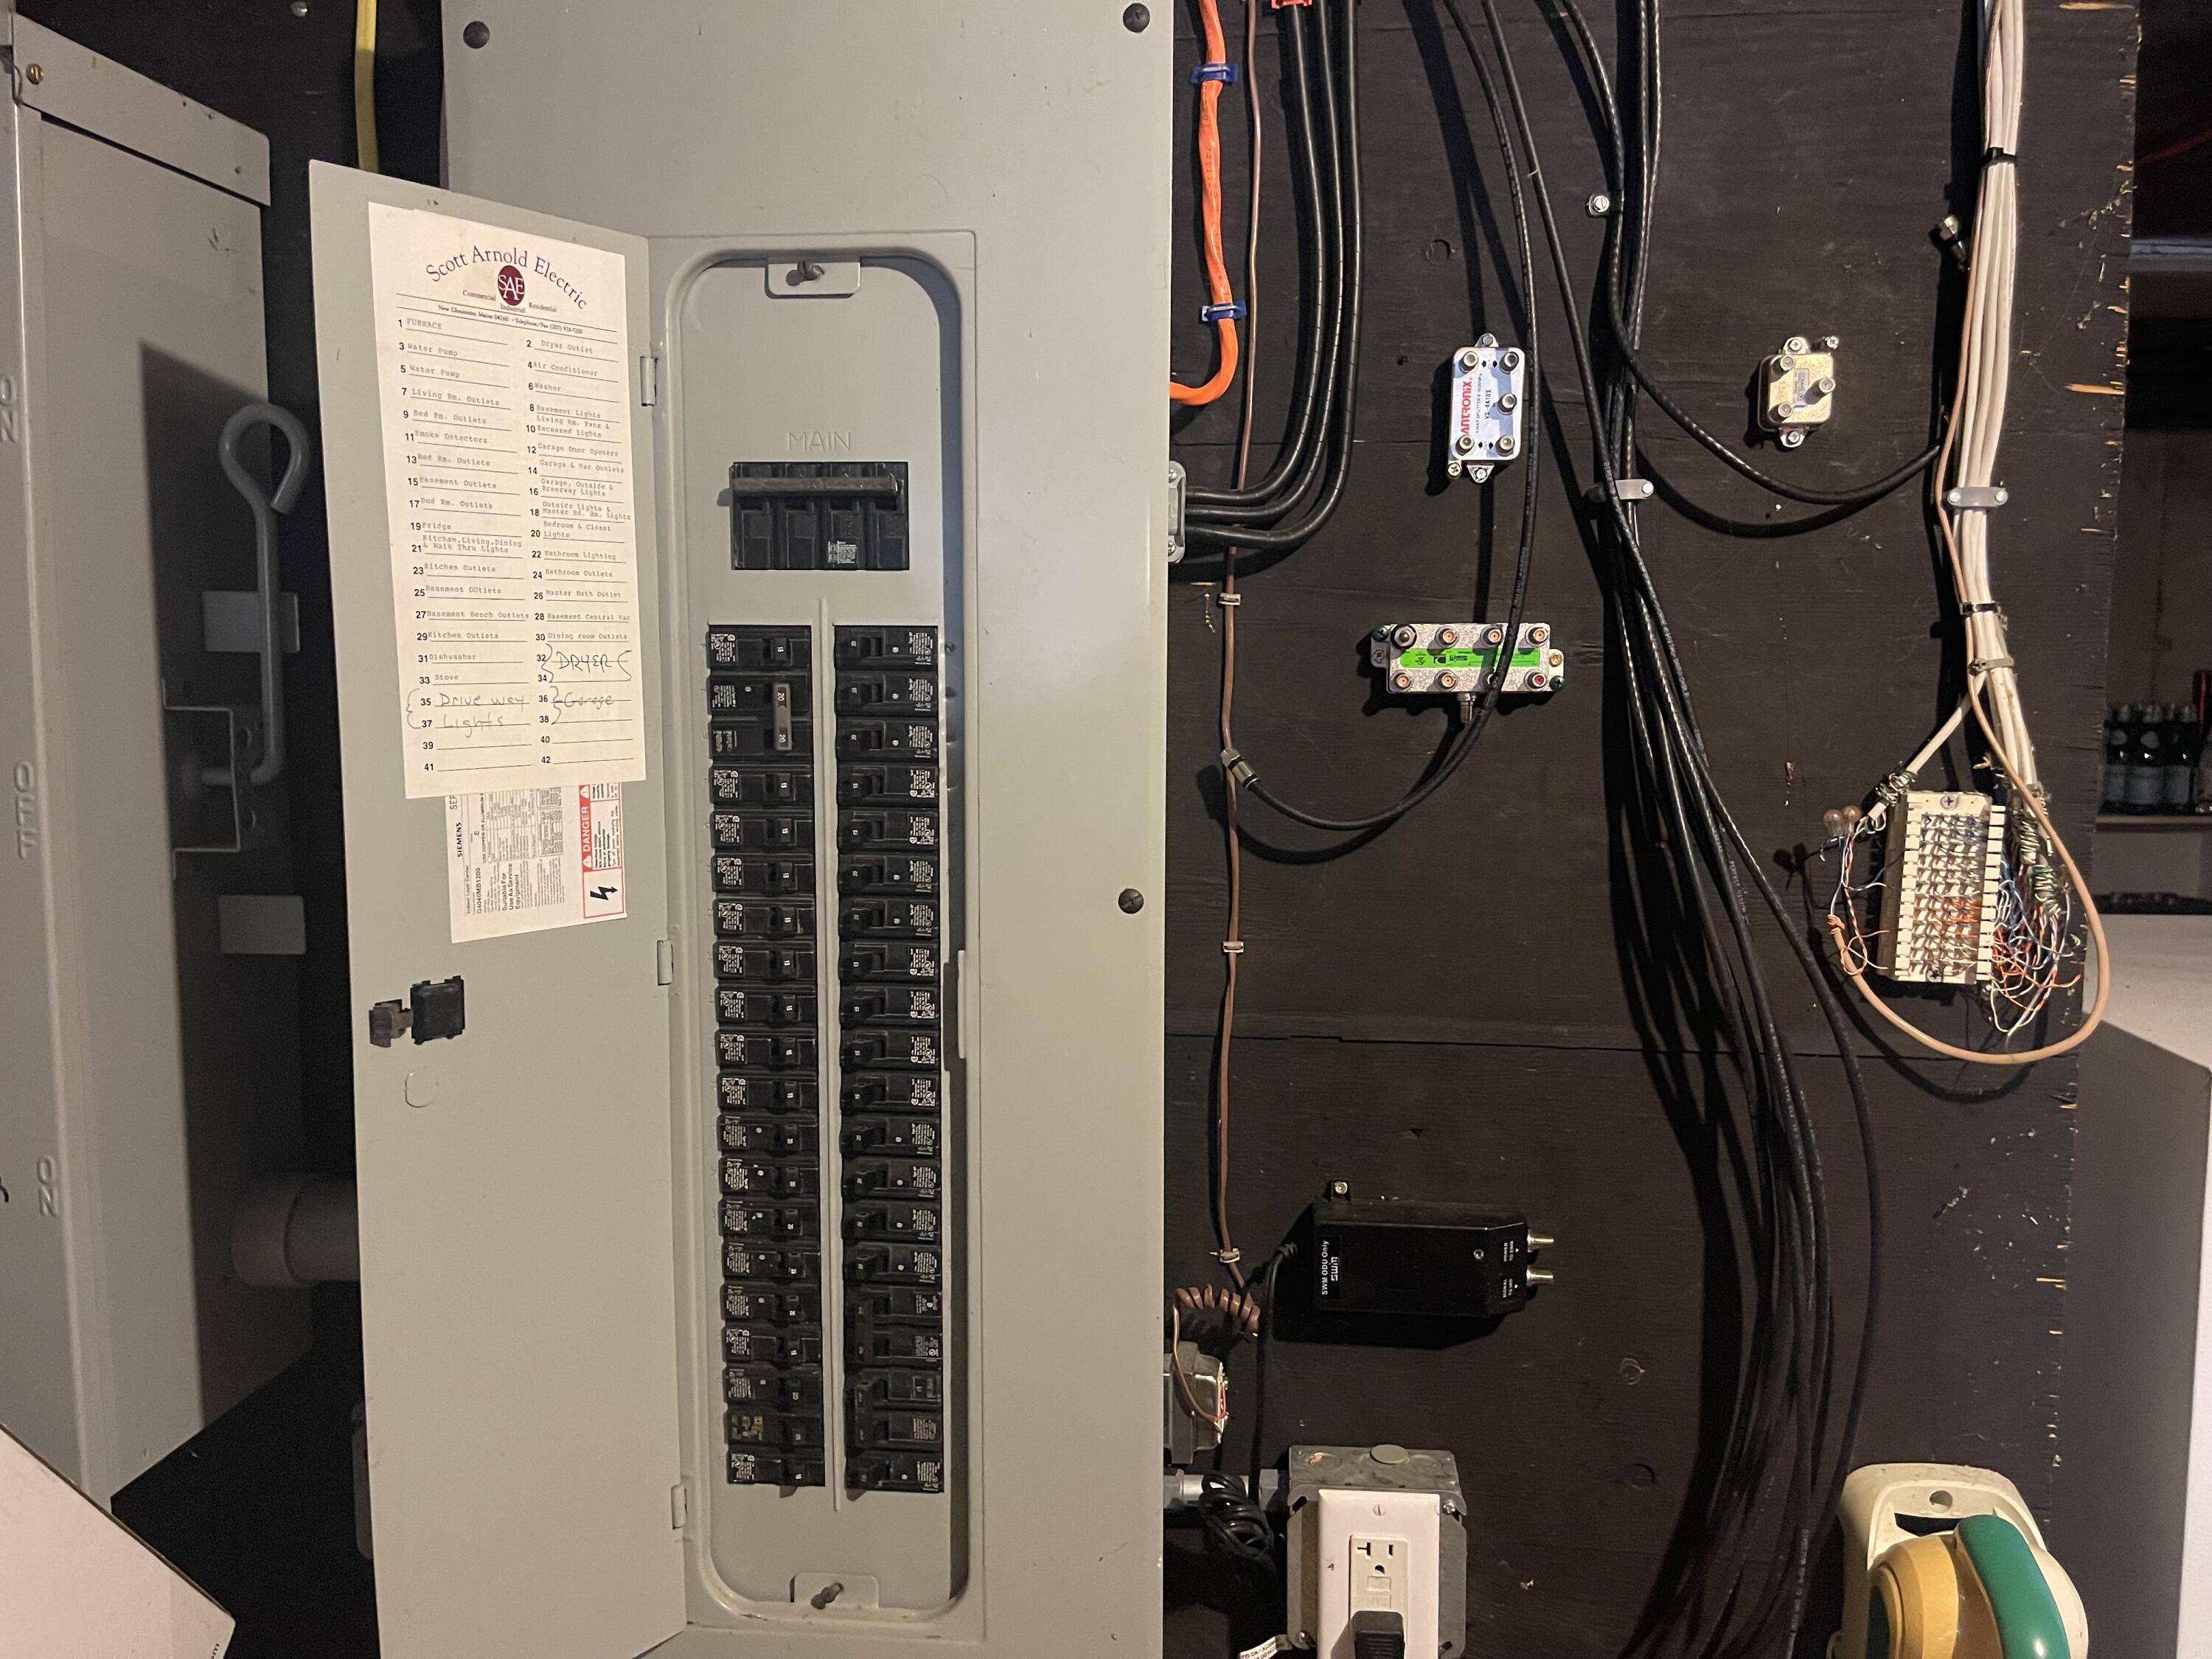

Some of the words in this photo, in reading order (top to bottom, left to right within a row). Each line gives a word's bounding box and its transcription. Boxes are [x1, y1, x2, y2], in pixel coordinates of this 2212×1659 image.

[426, 253, 468, 282] Scott
[473, 245, 527, 268] Arnold
[535, 256, 587, 310] Electric
[498, 275, 525, 301] SAE
[462, 290, 496, 301] Commercial
[529, 302, 557, 313] Residential
[398, 319, 402, 327] 1
[406, 318, 442, 330] FURNACE
[399, 342, 404, 350] 3
[408, 343, 433, 352] Water
[438, 347, 458, 357] Pump
[541, 340, 563, 349] Dryer
[567, 344, 593, 354] Outlet
[400, 365, 406, 373] 5
[409, 365, 435, 375] Water
[440, 369, 460, 378] Pump
[533, 361, 546, 369] Air
[551, 365, 598, 376] Conditioner
[535, 383, 561, 392] Washer
[401, 387, 407, 395] 7
[411, 389, 442, 400] Living
[448, 393, 461, 401] Rm.
[467, 396, 500, 406] Outlets
[529, 403, 535, 411] 8
[536, 405, 571, 414] Basement
[576, 410, 601, 419] Lights
[453, 414, 487, 424] Outlets
[537, 415, 563, 425] Living
[526, 425, 535, 433] 10
[405, 433, 414, 441] 11
[414, 430, 439, 438] Smoke
[445, 433, 487, 443] Detectors
[788, 431, 851, 451] MAIN
[538, 443, 564, 452] Garage
[406, 456, 417, 464] 13
[457, 457, 490, 466] Outlets
[528, 467, 538, 475] 14
[540, 459, 566, 468] Garage
[596, 465, 625, 473] Outlets
[408, 478, 418, 486] 15
[420, 476, 459, 485] Basement
[464, 480, 496, 489] Outlets
[408, 500, 420, 508] 17
[460, 501, 493, 509] Outlets
[410, 522, 421, 530] 19
[422, 522, 451, 531] Fridge
[531, 529, 540, 538] 20
[544, 531, 570, 539] Lights
[411, 544, 421, 552] 21
[433, 542, 453, 550] Walk
[583, 552, 616, 560] Lighting
[413, 566, 423, 575] 23
[425, 563, 458, 571] Kitchen
[414, 588, 425, 597] 25
[416, 611, 426, 619] 27
[417, 633, 428, 641] 29
[418, 655, 428, 663] 31
[557, 651, 612, 672] DRYER
[420, 676, 430, 684] 33
[538, 674, 547, 682] 34
[777, 692, 785, 701] 20
[421, 720, 432, 728] 37
[539, 715, 549, 723] 38
[443, 712, 503, 738] Lights
[779, 734, 786, 742] 20
[541, 756, 551, 764] 42
[424, 763, 434, 771] 41
[13, 761, 36, 860] OFF
[581, 806, 591, 852] DANGER
[508, 888, 514, 897] As
[37, 1155, 59, 1218] ON
[1321, 1240, 1329, 1257] Only
